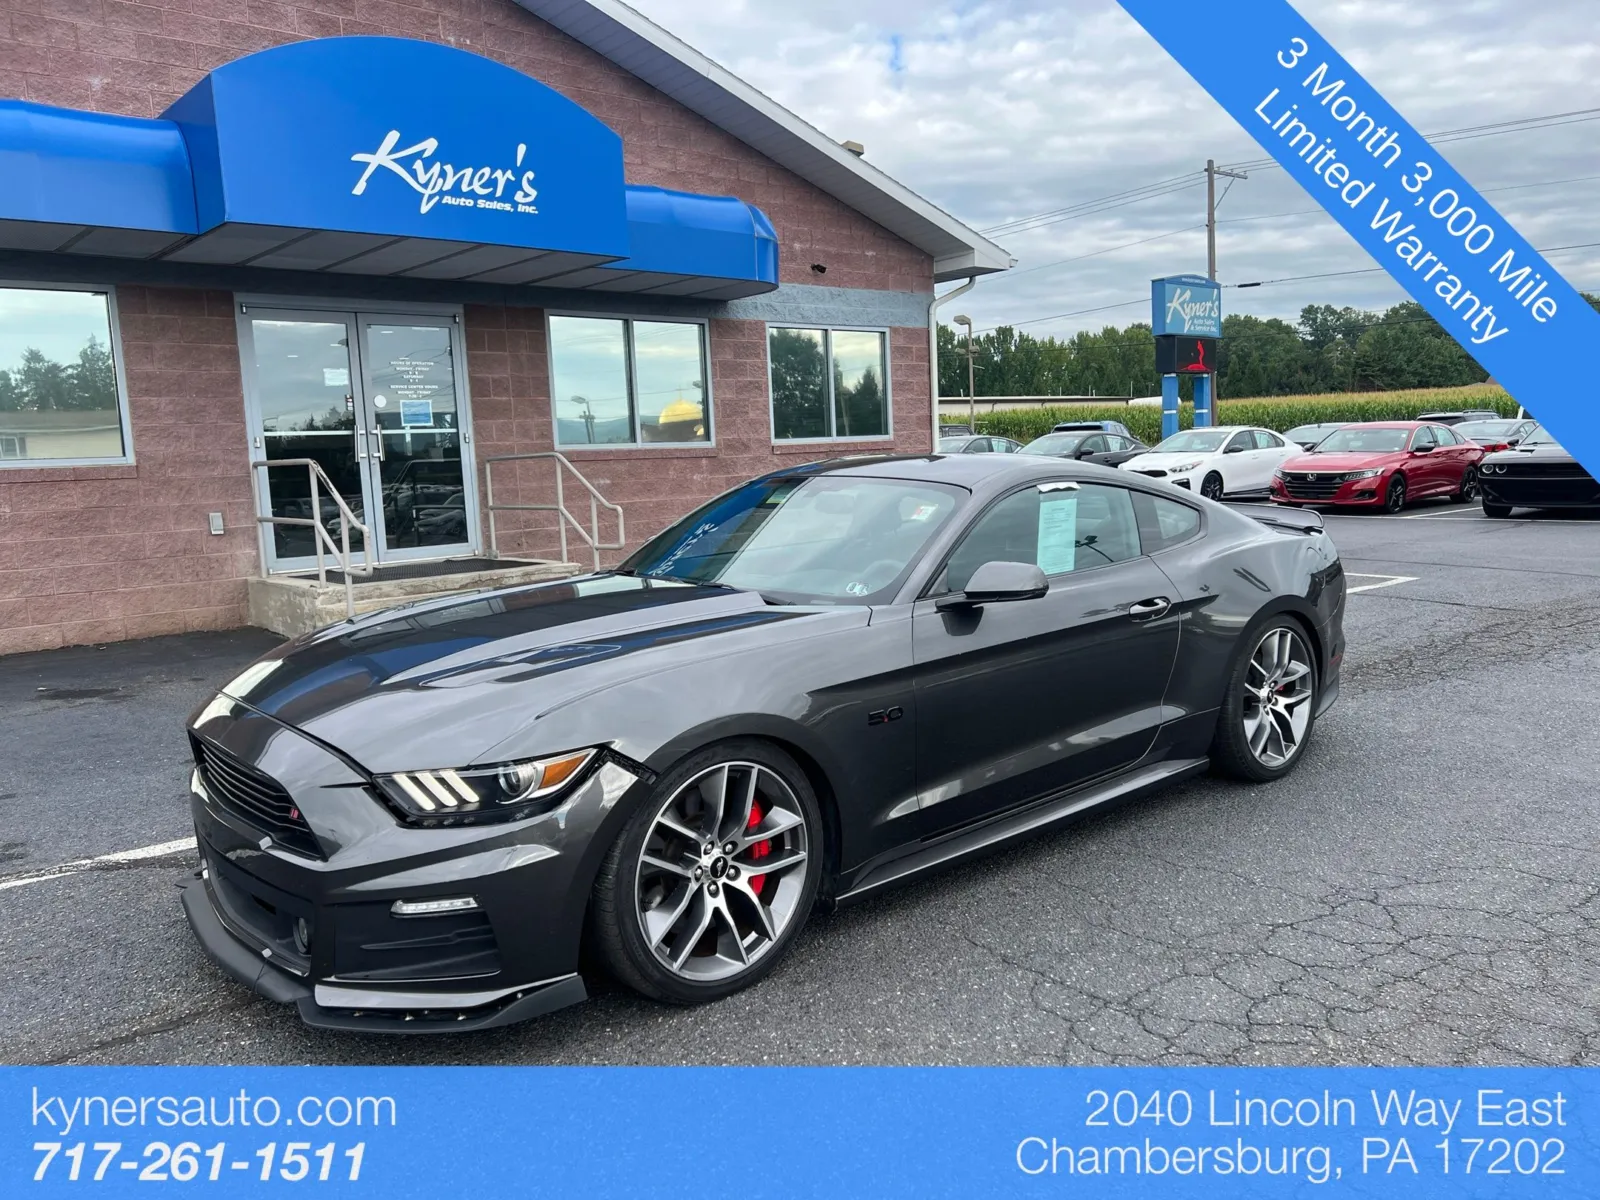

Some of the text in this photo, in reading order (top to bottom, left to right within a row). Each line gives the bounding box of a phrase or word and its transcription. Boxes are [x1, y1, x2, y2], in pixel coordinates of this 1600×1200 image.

[350, 129, 538, 215] Kyner's
[441, 195, 540, 214] Auto Sales, Inc.
[1166, 288, 1218, 333] Kyner's
[868, 705, 903, 726] 5.0
